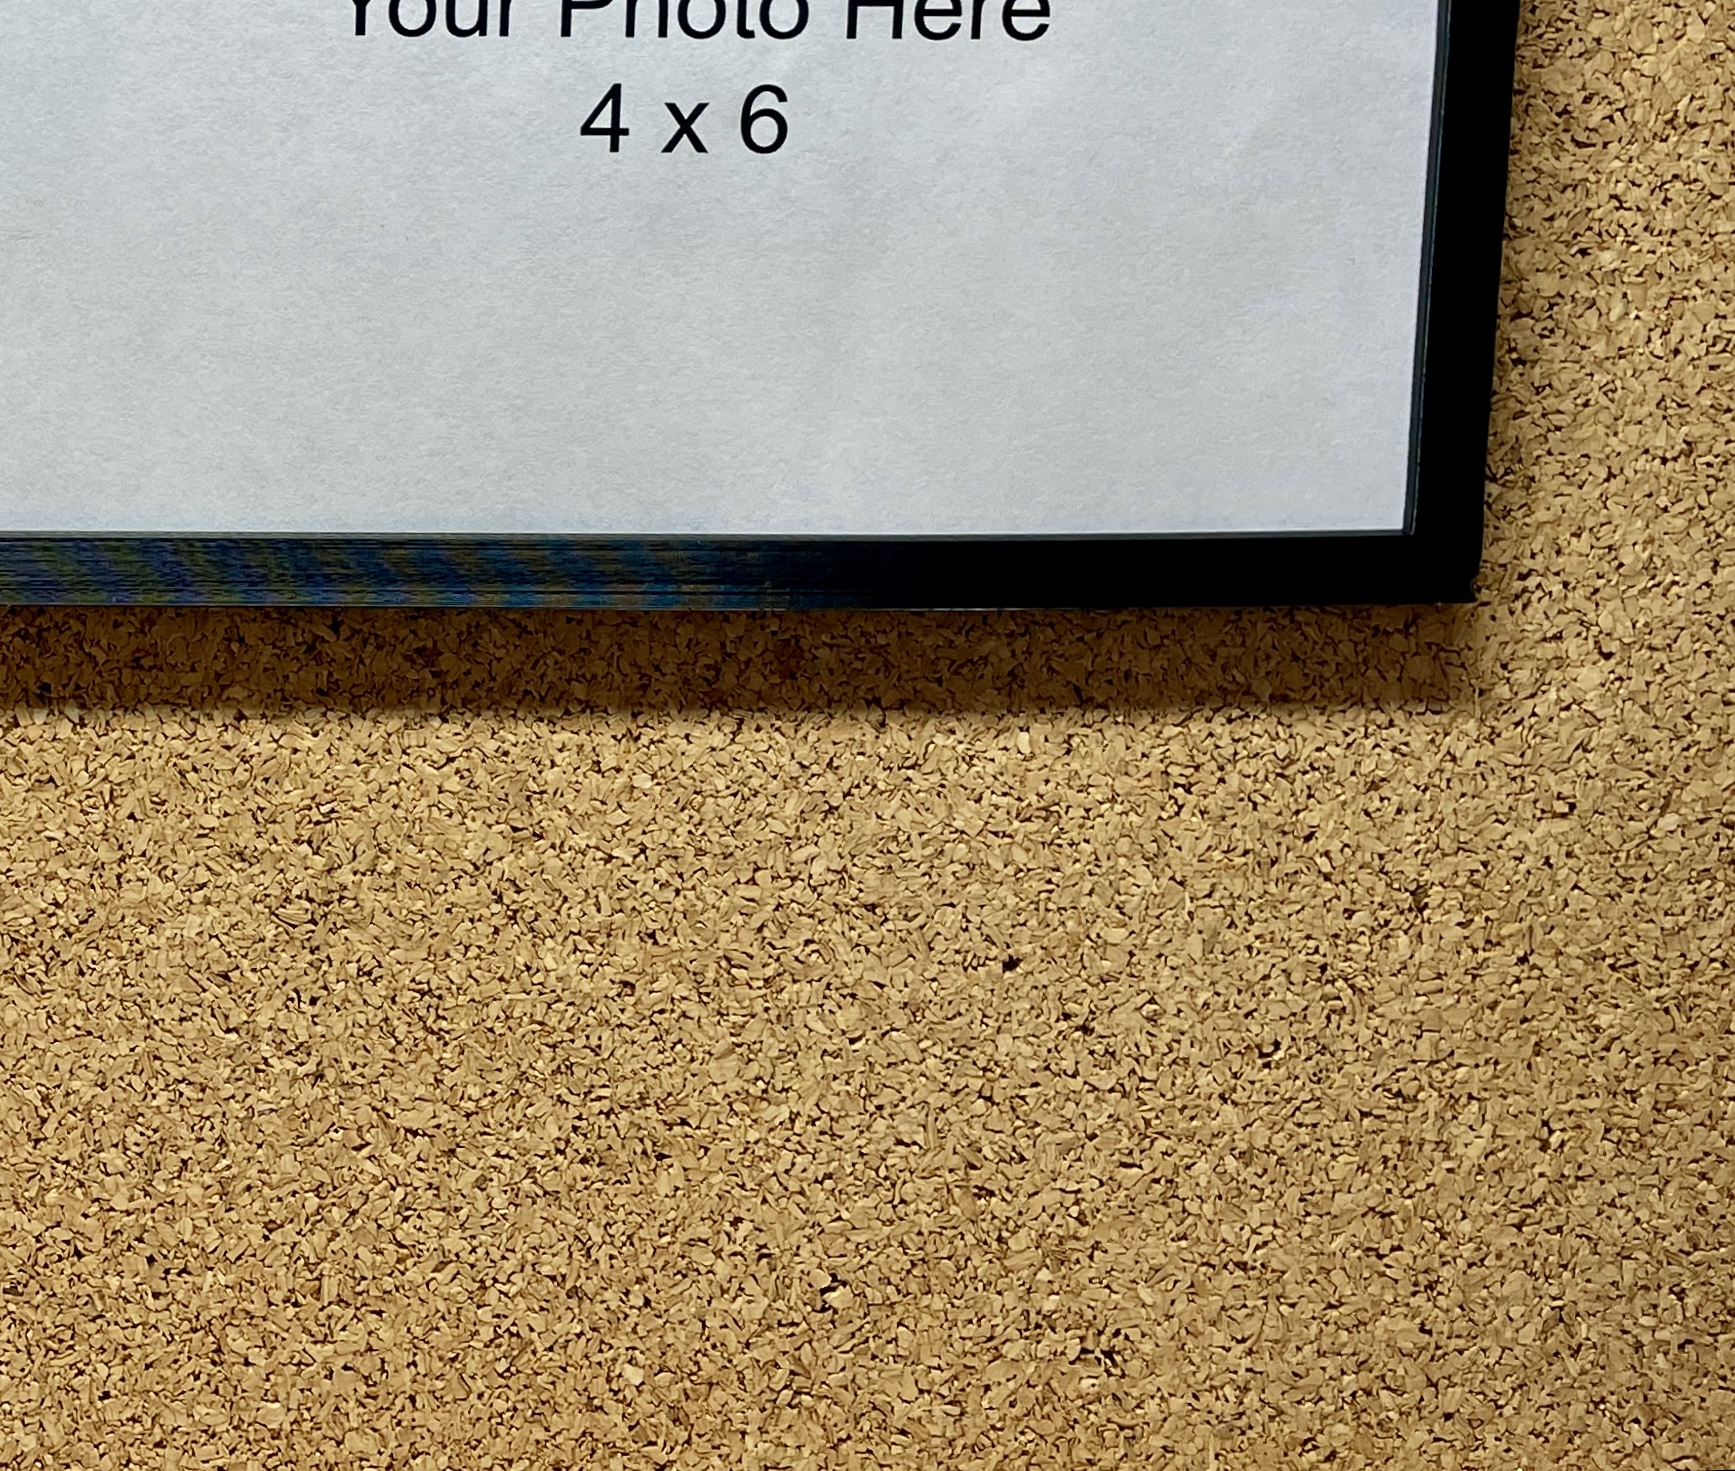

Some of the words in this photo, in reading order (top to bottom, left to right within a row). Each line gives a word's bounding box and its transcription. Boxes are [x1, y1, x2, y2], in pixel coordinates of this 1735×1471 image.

[579, 81, 631, 154] 4
[660, 101, 711, 155] x
[739, 83, 789, 156] 6
